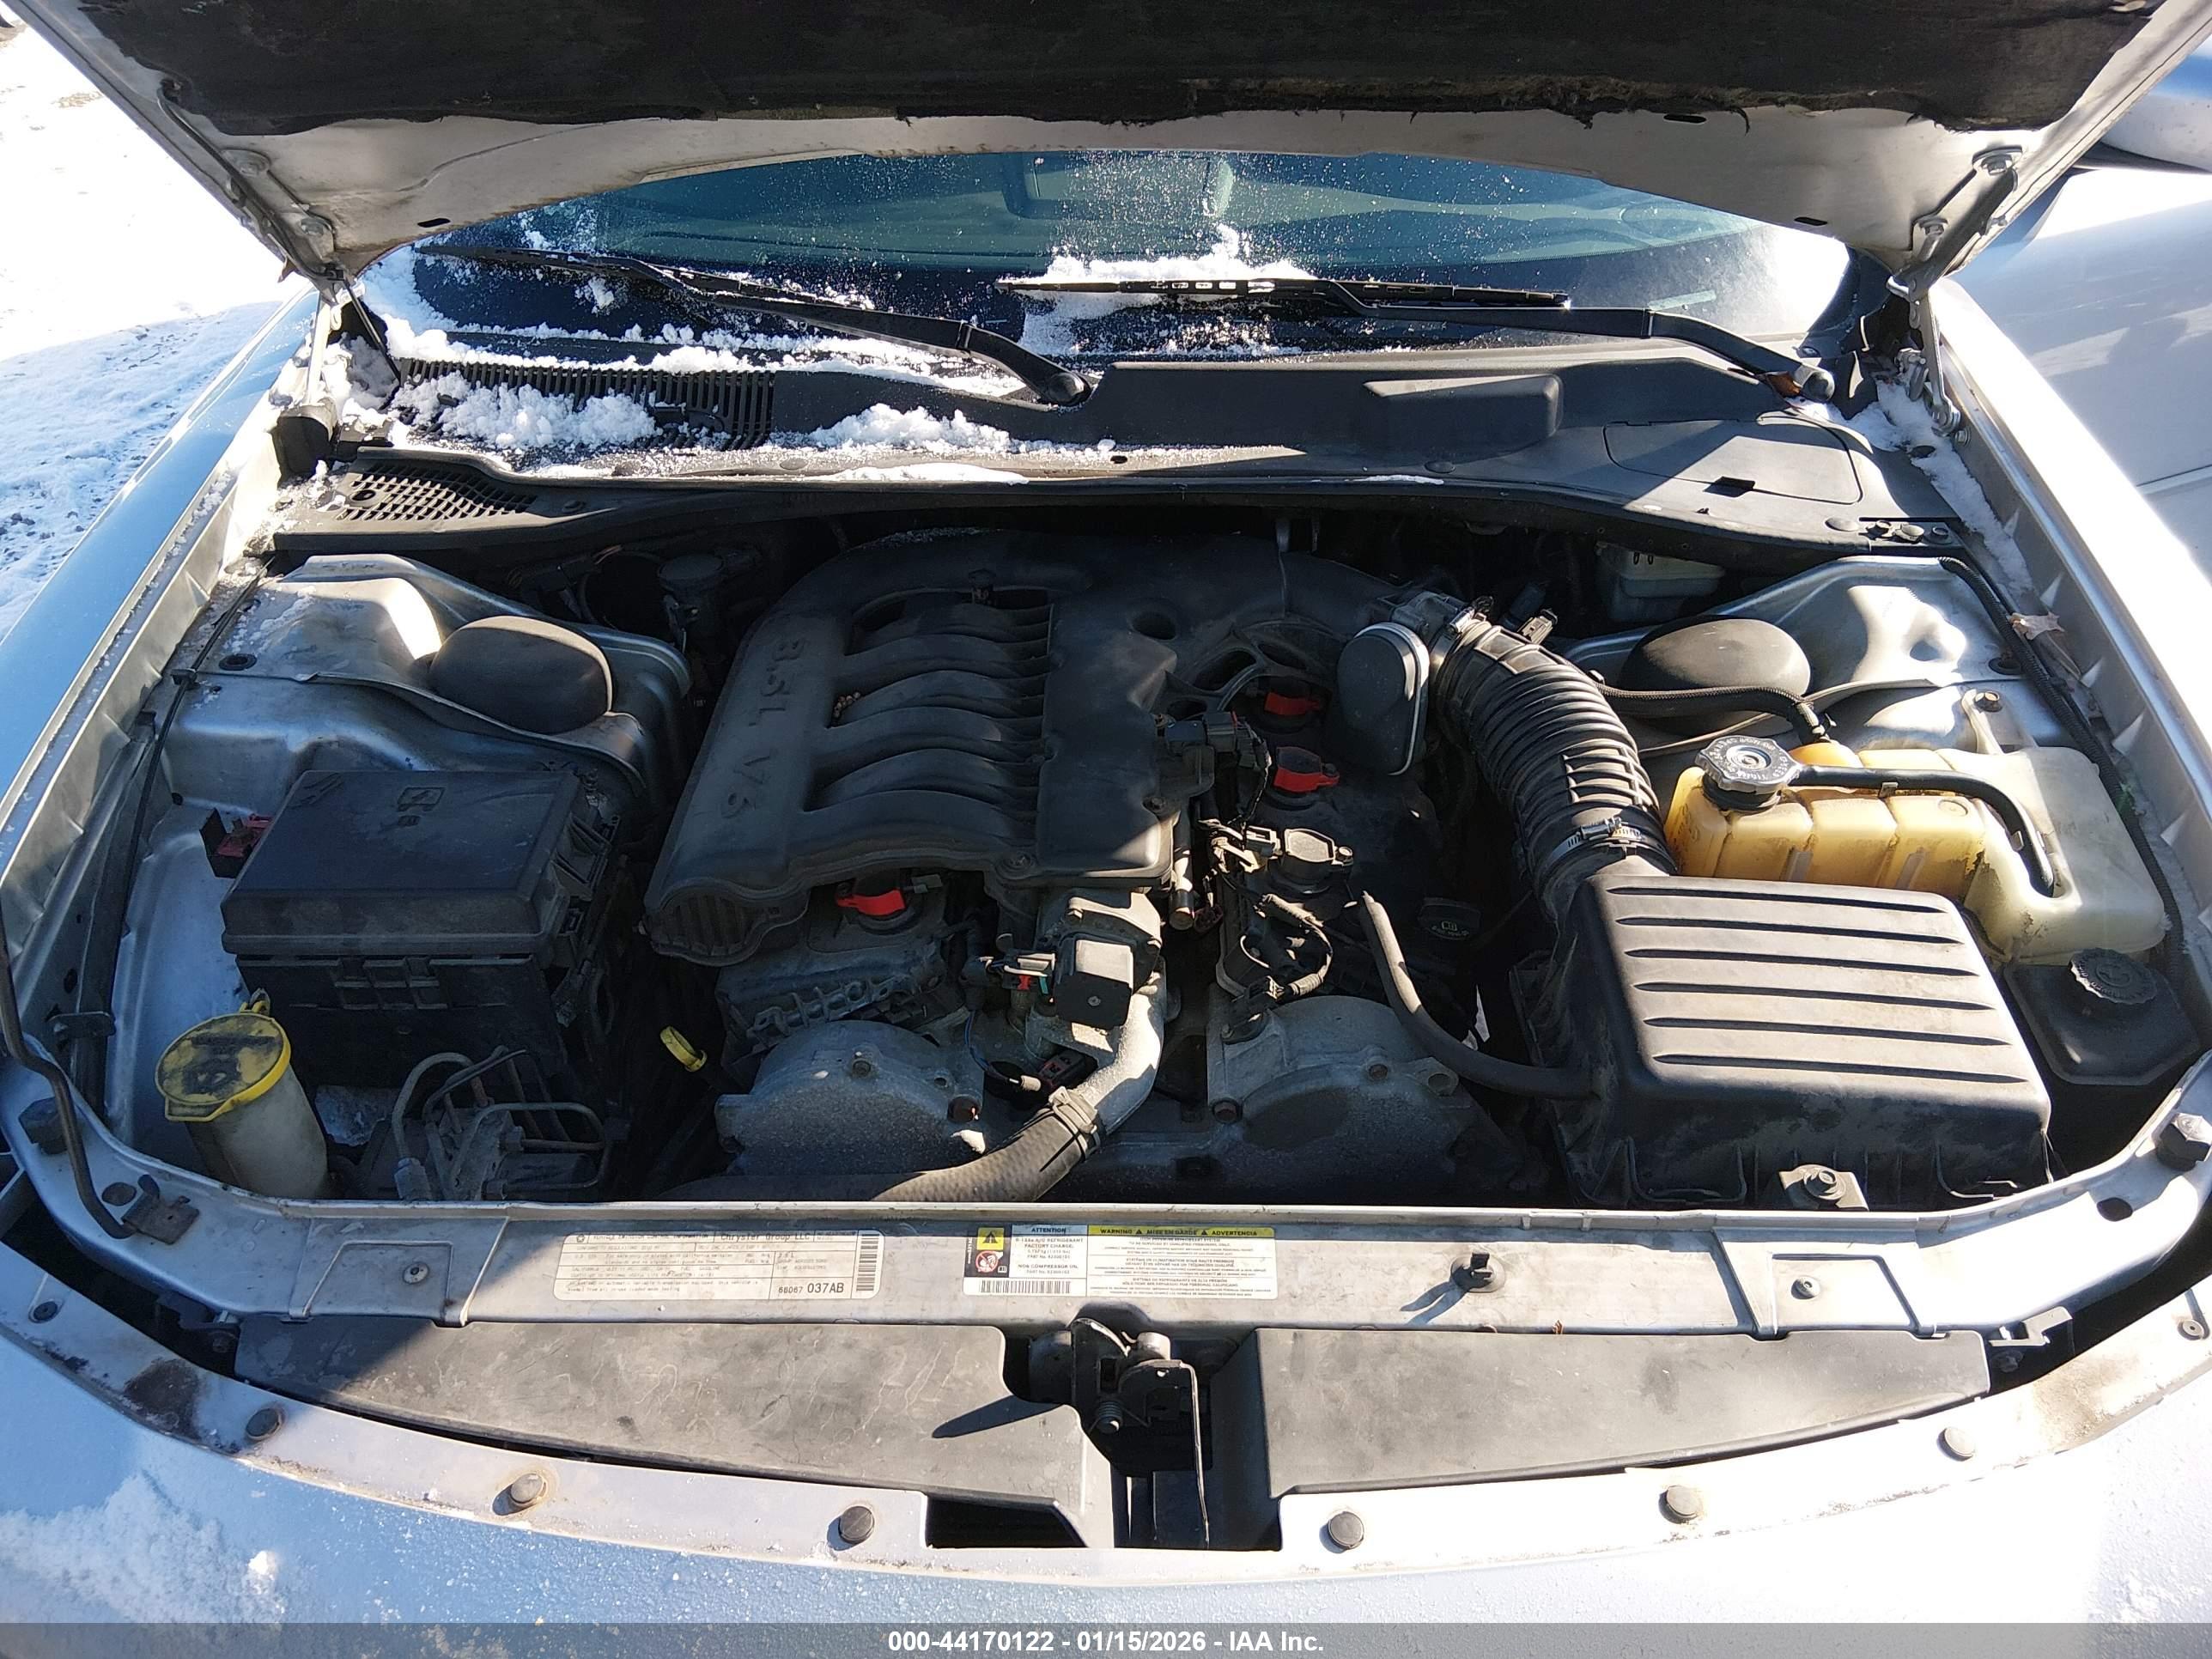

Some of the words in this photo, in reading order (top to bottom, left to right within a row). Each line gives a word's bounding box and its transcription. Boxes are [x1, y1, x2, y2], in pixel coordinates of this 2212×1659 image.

[720, 749, 779, 818] V6
[765, 1233, 791, 1243] Group
[807, 1282, 845, 1294] 037AB
